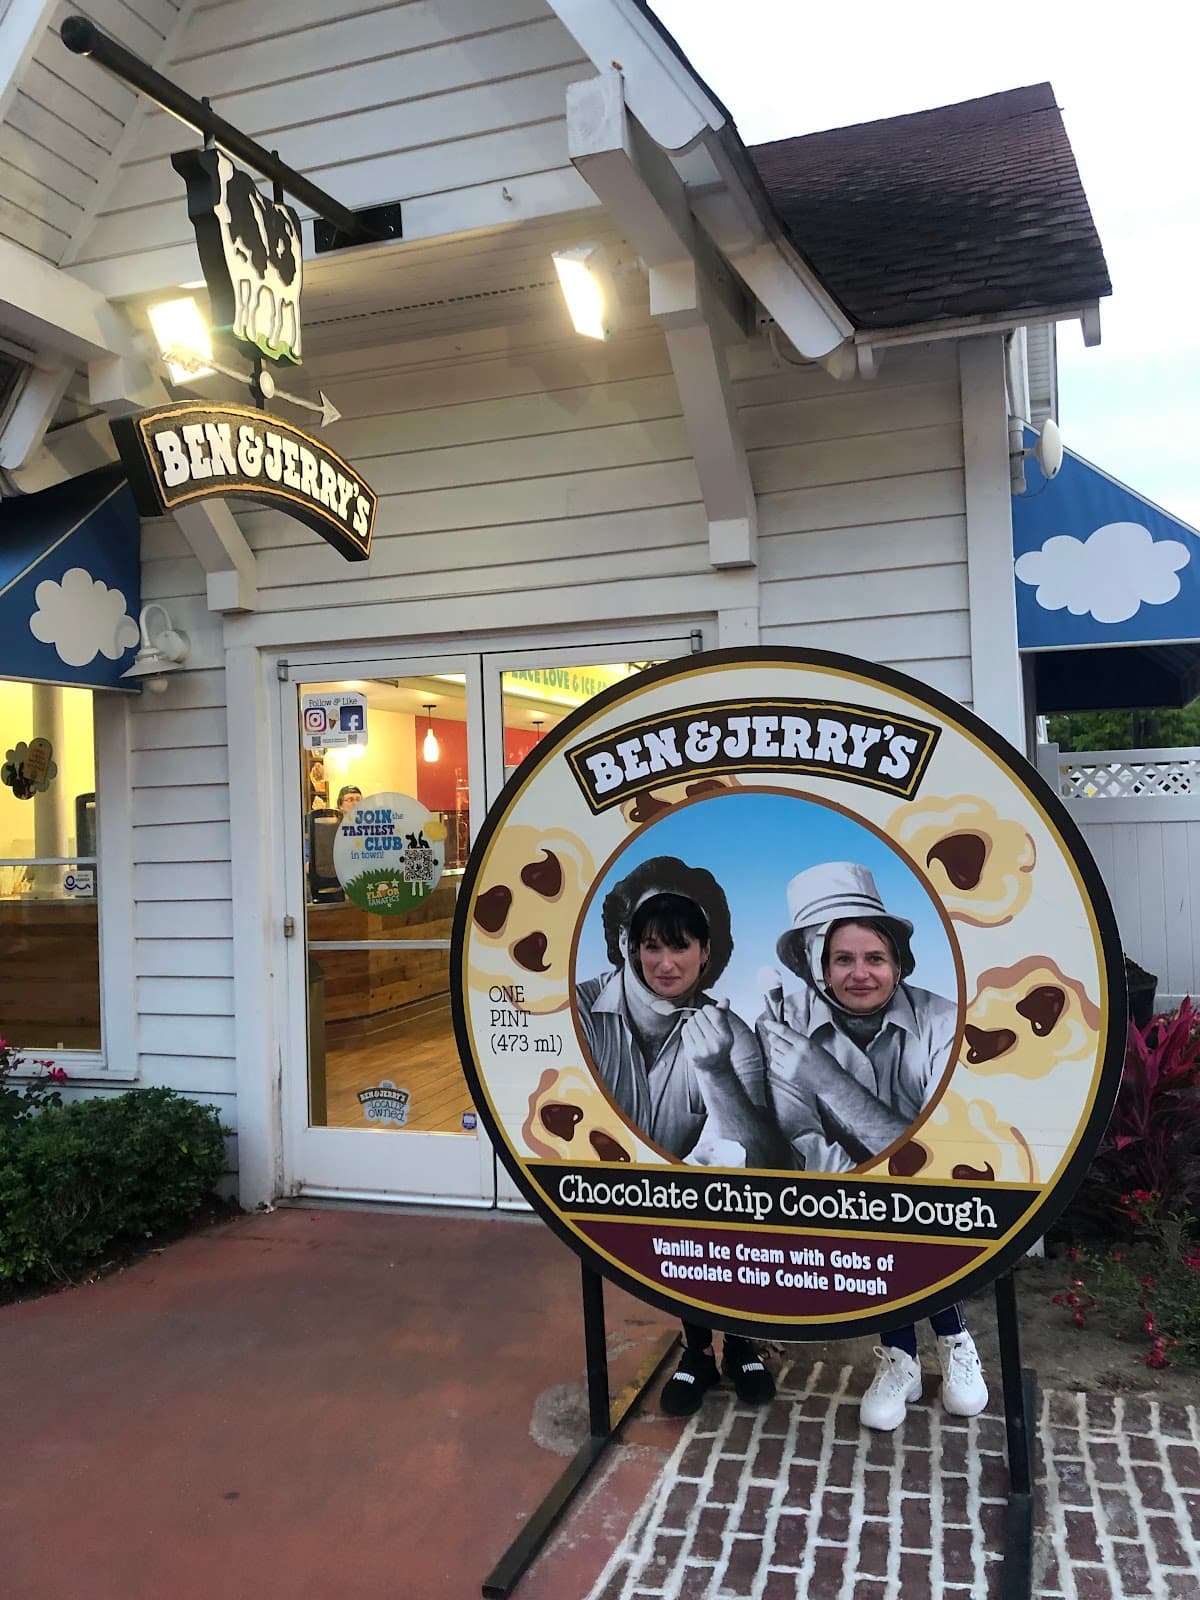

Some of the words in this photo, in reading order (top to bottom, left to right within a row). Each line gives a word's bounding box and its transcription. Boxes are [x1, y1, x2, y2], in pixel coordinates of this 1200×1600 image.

[155, 423, 237, 487] BEN
[238, 425, 263, 477] &
[264, 431, 370, 537] JERRY'S
[543, 669, 570, 689] LOVE
[581, 676, 595, 696] ICE
[308, 697, 332, 707] Follow
[342, 696, 358, 705] Like
[586, 727, 685, 795] BEN
[685, 720, 722, 763] &
[723, 715, 918, 780] JERRY'S
[355, 809, 392, 824] JOIN
[392, 812, 404, 820] the
[341, 824, 395, 836] TASTIEST
[364, 836, 403, 851] CLUB
[351, 851, 360, 859] in
[361, 850, 385, 859] town!
[368, 896, 400, 906] FANATICS
[488, 985, 525, 1003] ONE
[490, 1009, 531, 1027] PINT
[491, 1034, 529, 1055] (473
[533, 1034, 563, 1057] ml)
[558, 1174, 699, 1210] Chocolate
[704, 1183, 773, 1221] Chip
[779, 1186, 887, 1222] Cookie
[891, 1192, 998, 1232] Dough
[652, 1238, 704, 1259] Vanilla
[708, 1242, 731, 1260] Ice
[735, 1243, 785, 1264] Cream
[789, 1247, 826, 1267] with
[829, 1250, 872, 1271] Gobs
[876, 1254, 894, 1272] of
[660, 1261, 733, 1283] Chocolate
[737, 1266, 771, 1287] Chip
[775, 1269, 829, 1291] Cookie
[833, 1273, 887, 1296] Dough
[672, 1372, 696, 1384] PUMA
